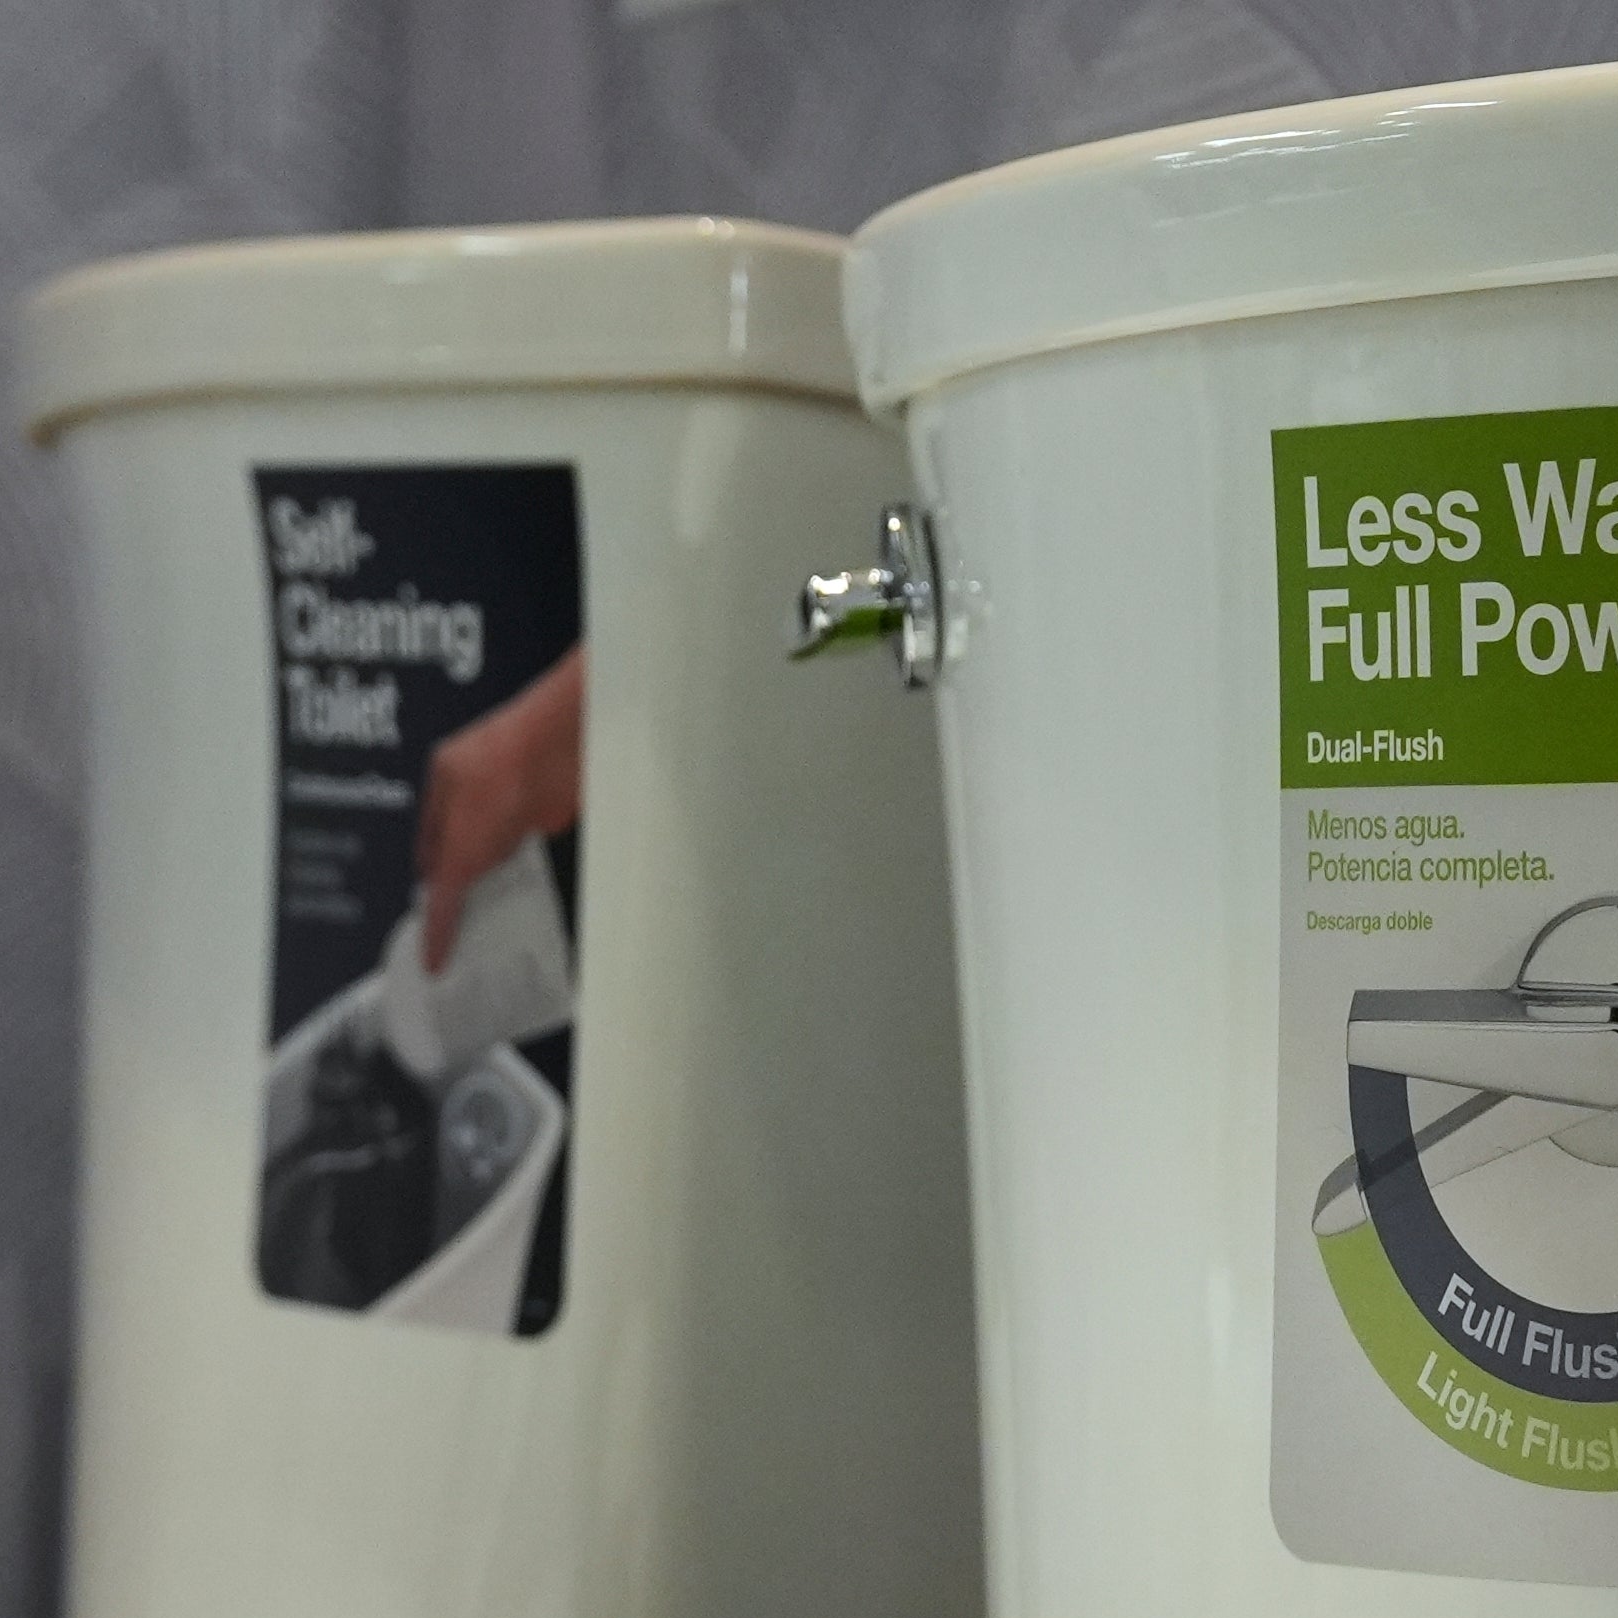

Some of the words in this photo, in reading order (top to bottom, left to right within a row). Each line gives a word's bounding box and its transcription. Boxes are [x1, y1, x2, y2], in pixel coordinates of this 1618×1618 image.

[1303, 475, 1482, 568] Less
[1307, 584, 1432, 682] Full
[1307, 729, 1444, 763] Dual-Flush
[1308, 809, 1387, 840] Menos
[1394, 814, 1465, 846] agua.
[1308, 849, 1412, 882] Potencia
[1419, 850, 1555, 888] completa.
[1307, 911, 1381, 935] Descarga
[1386, 911, 1432, 930] doble
[1437, 1273, 1515, 1354] Full
[1415, 1351, 1513, 1450] Light
